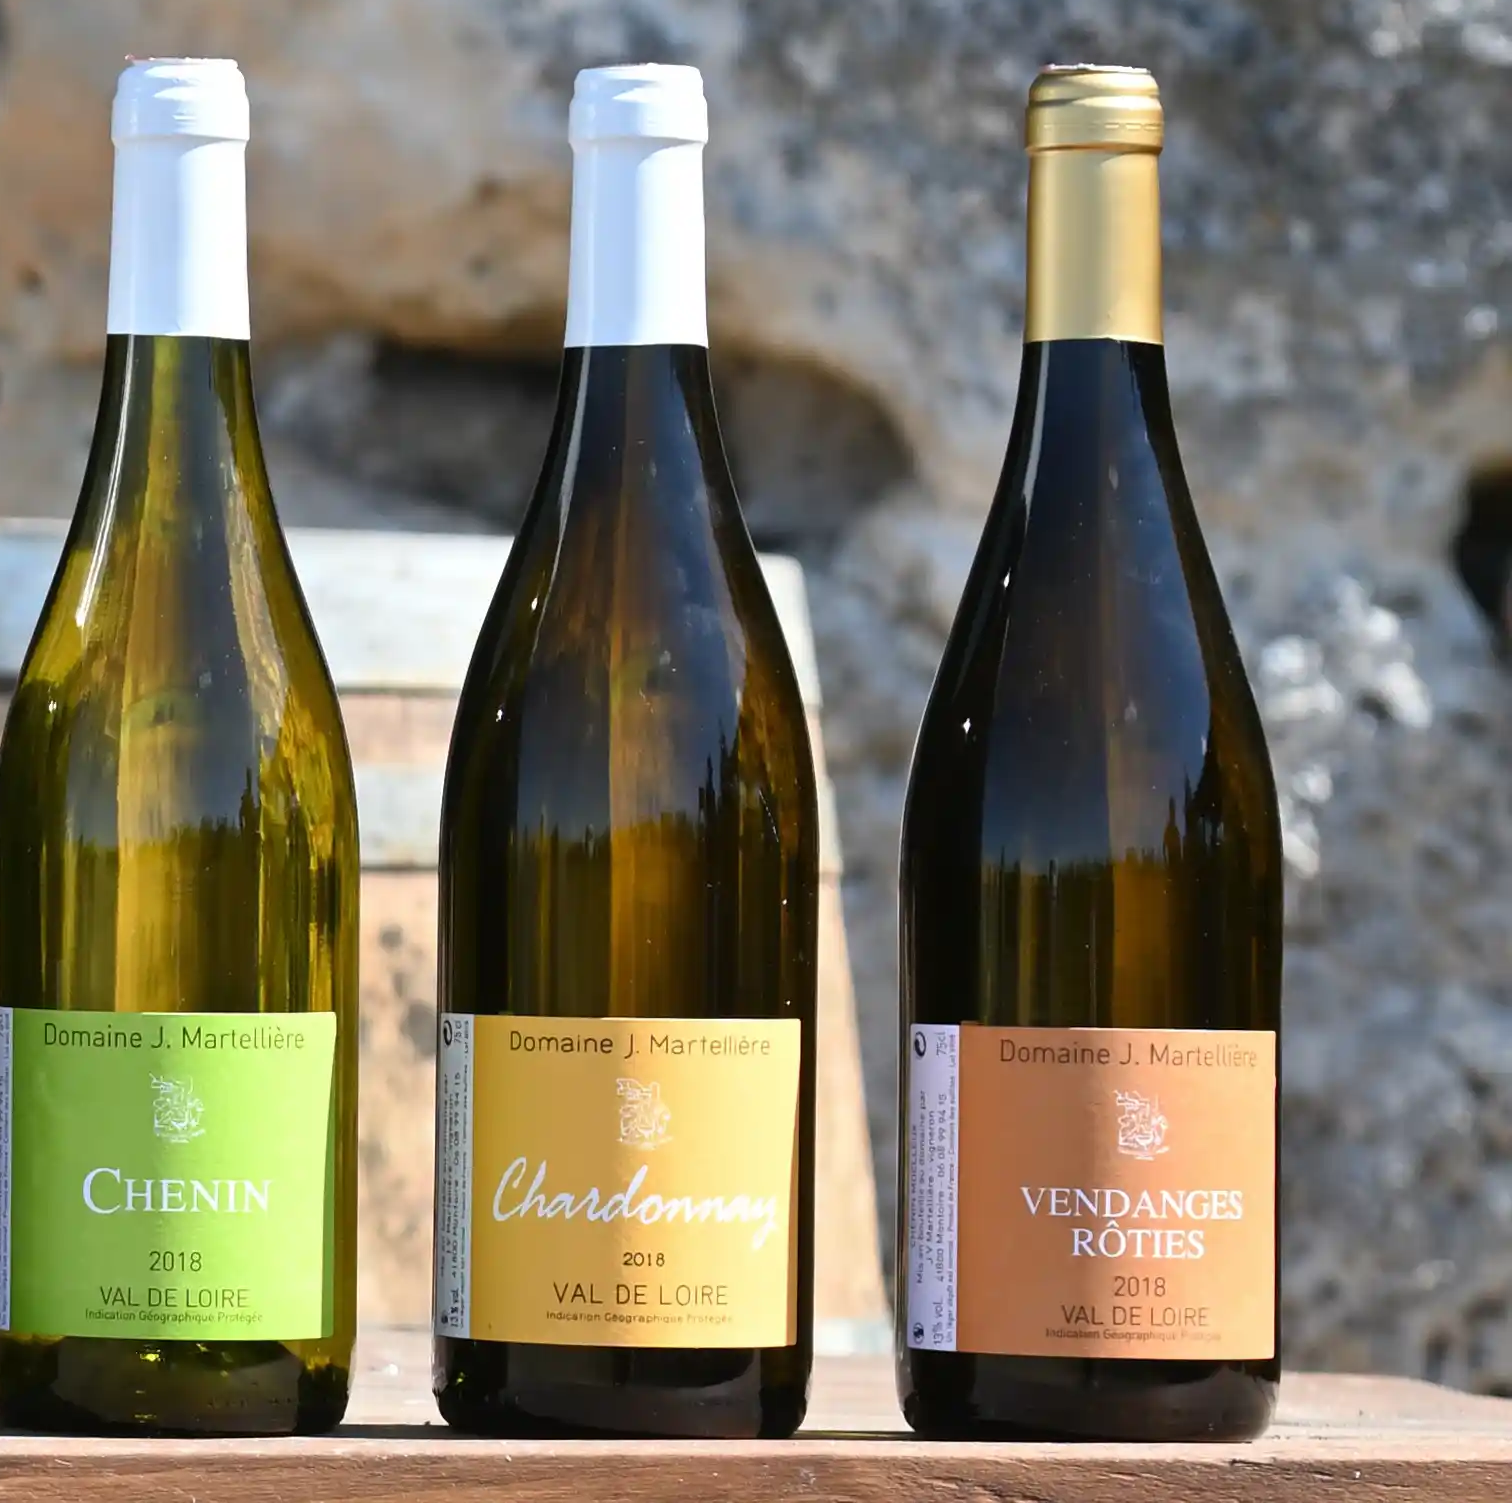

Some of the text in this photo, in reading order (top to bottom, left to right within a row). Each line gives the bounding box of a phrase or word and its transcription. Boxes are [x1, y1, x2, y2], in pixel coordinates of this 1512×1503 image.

[44, 1022, 305, 1050] Domaine J. Martellière
[510, 1031, 771, 1059] Domaine J. Martellière
[1000, 1038, 1258, 1067] Domaine J. Martellière
[82, 1167, 274, 1215] CHENIN
[493, 1156, 778, 1250] Chardonnay
[1021, 1187, 1243, 1220] VENDANGES
[1072, 1220, 1205, 1259] RÔTIES
[149, 1250, 202, 1272] 2018
[623, 1252, 665, 1267] 2018
[100, 1286, 251, 1308] VAL DE LOIRE
[553, 1281, 728, 1307] VAL DE LOIRE
[1114, 1276, 1166, 1298] 2018
[85, 1309, 136, 1321] Indication
[138, 1310, 215, 1325] Géographique
[546, 1311, 601, 1322] Indication
[1062, 1304, 1210, 1327] VAL DE LOIRE
